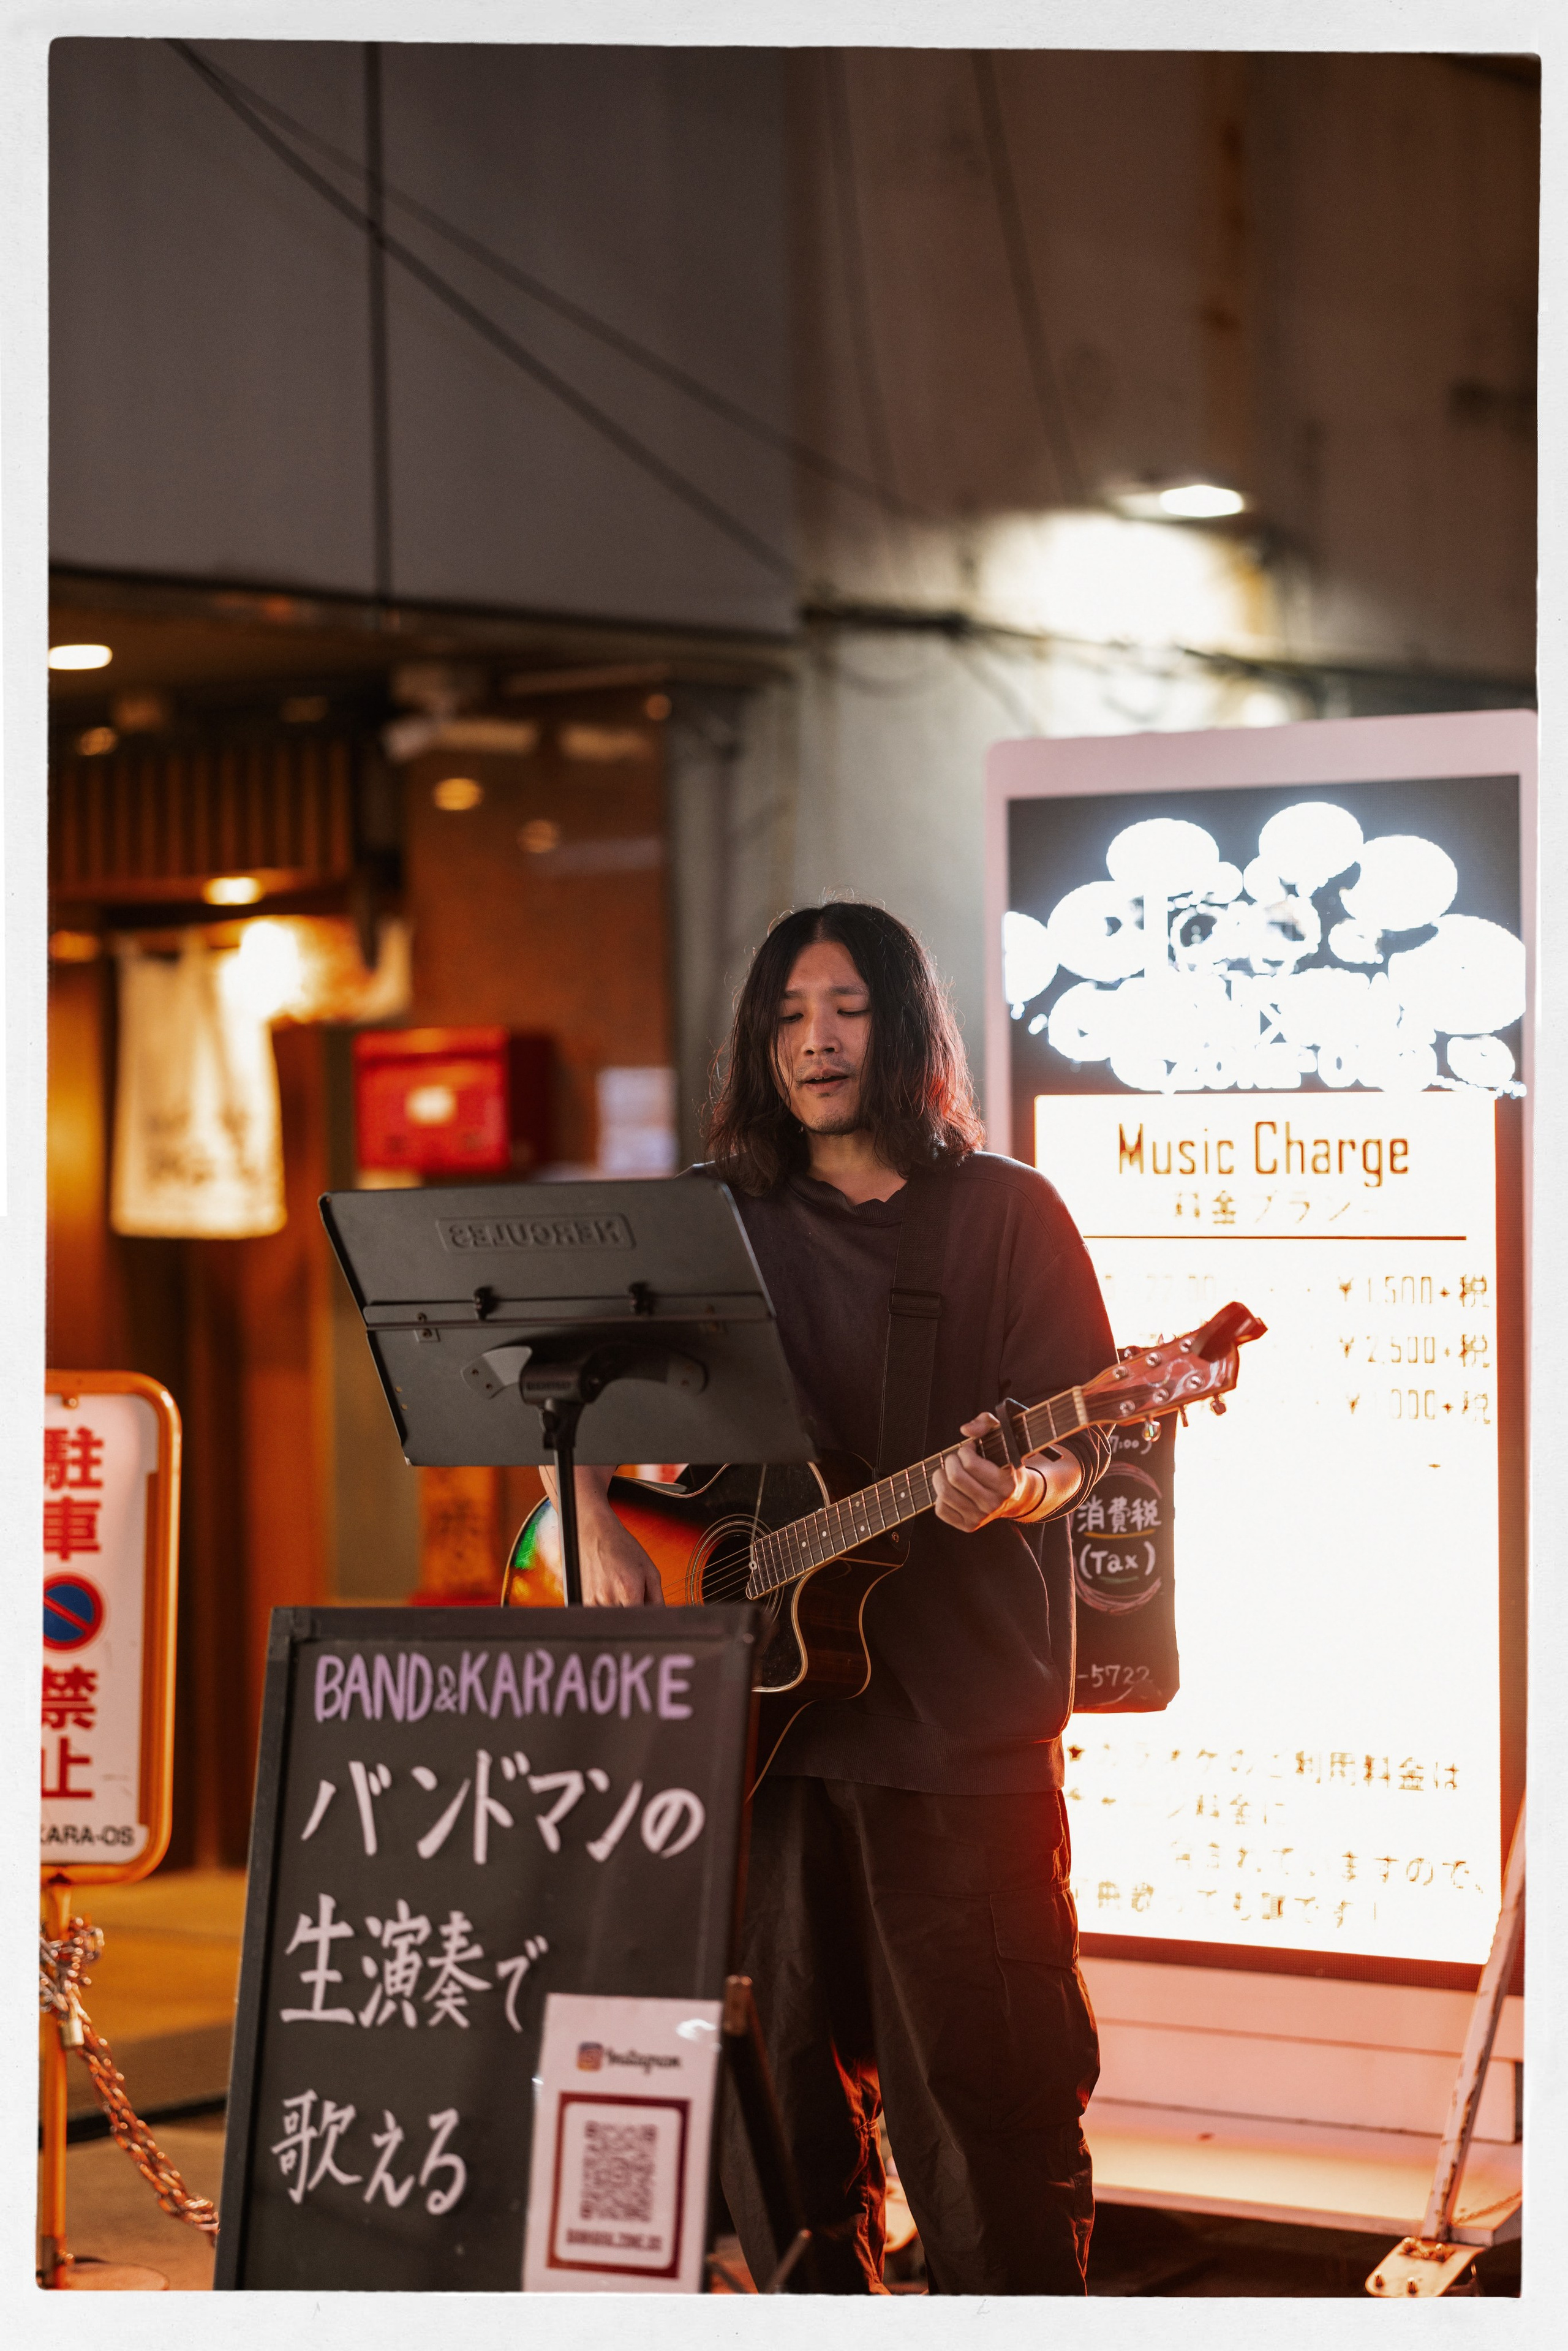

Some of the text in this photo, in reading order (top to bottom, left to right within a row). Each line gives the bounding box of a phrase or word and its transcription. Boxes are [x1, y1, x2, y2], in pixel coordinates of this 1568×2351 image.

[1118, 1121, 1410, 1188] Music Charge
[1077, 1495, 1162, 1534] 消費税
[1079, 1541, 1156, 1580] (Tax)
[300, 1749, 706, 1865] バンドマンの
[279, 1892, 549, 2032] 生演奏で
[271, 2089, 467, 2215] 歌える
